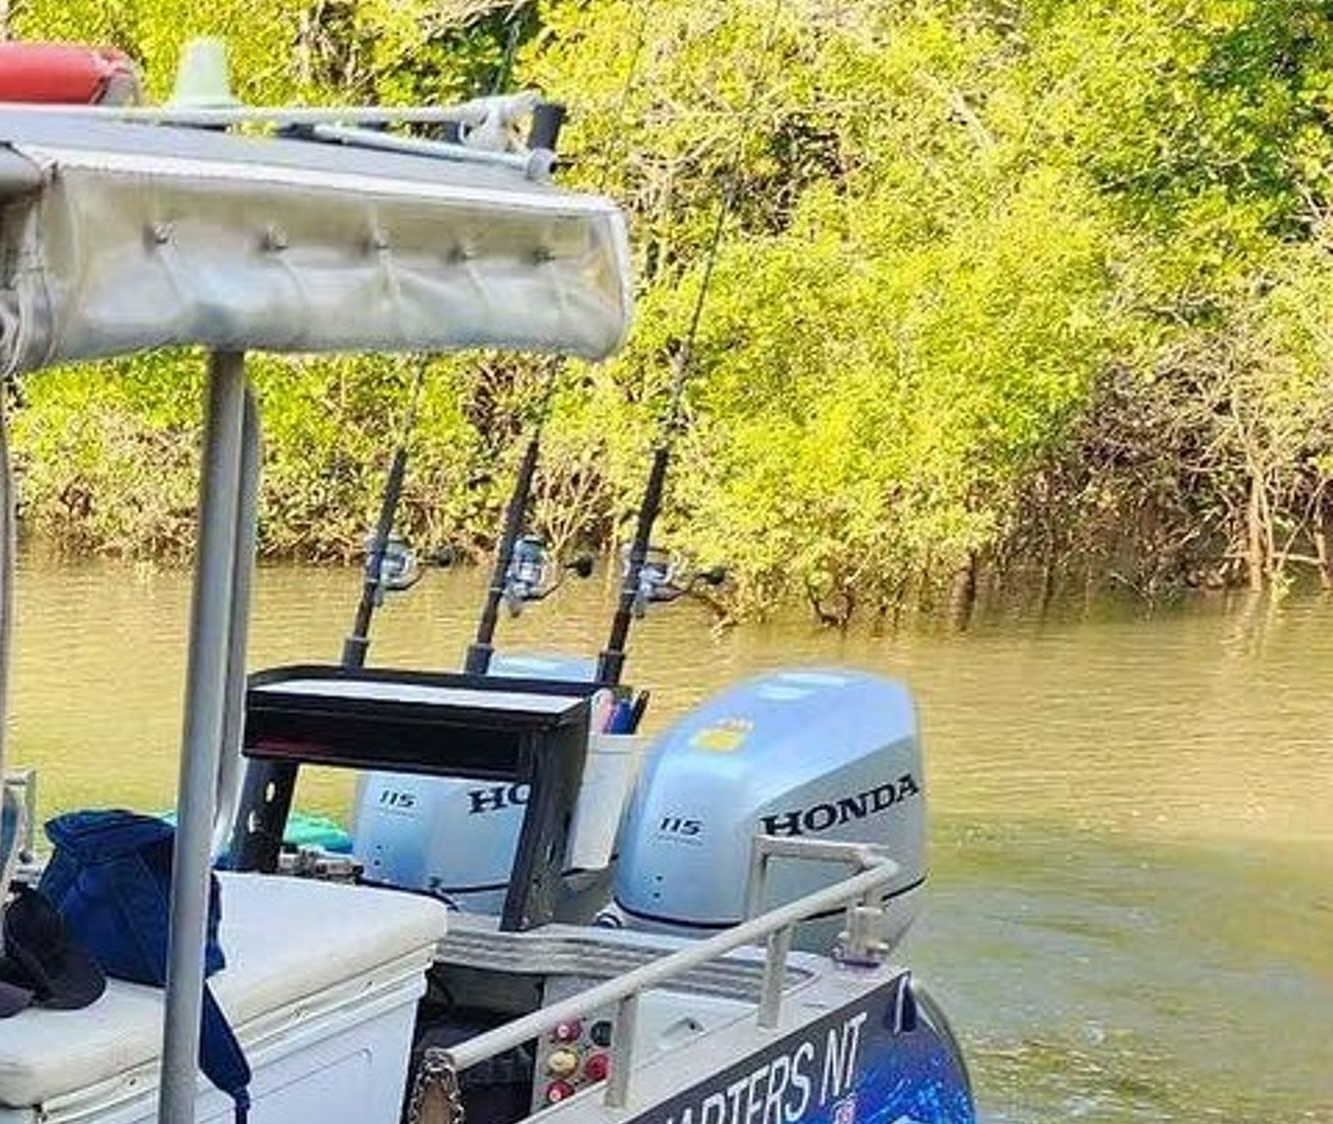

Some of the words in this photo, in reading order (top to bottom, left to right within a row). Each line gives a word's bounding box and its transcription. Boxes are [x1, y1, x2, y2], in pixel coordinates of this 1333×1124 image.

[379, 790, 417, 807] 115
[760, 773, 920, 836] HONDA
[660, 816, 703, 836] 115
[819, 1012, 867, 1106] NT
